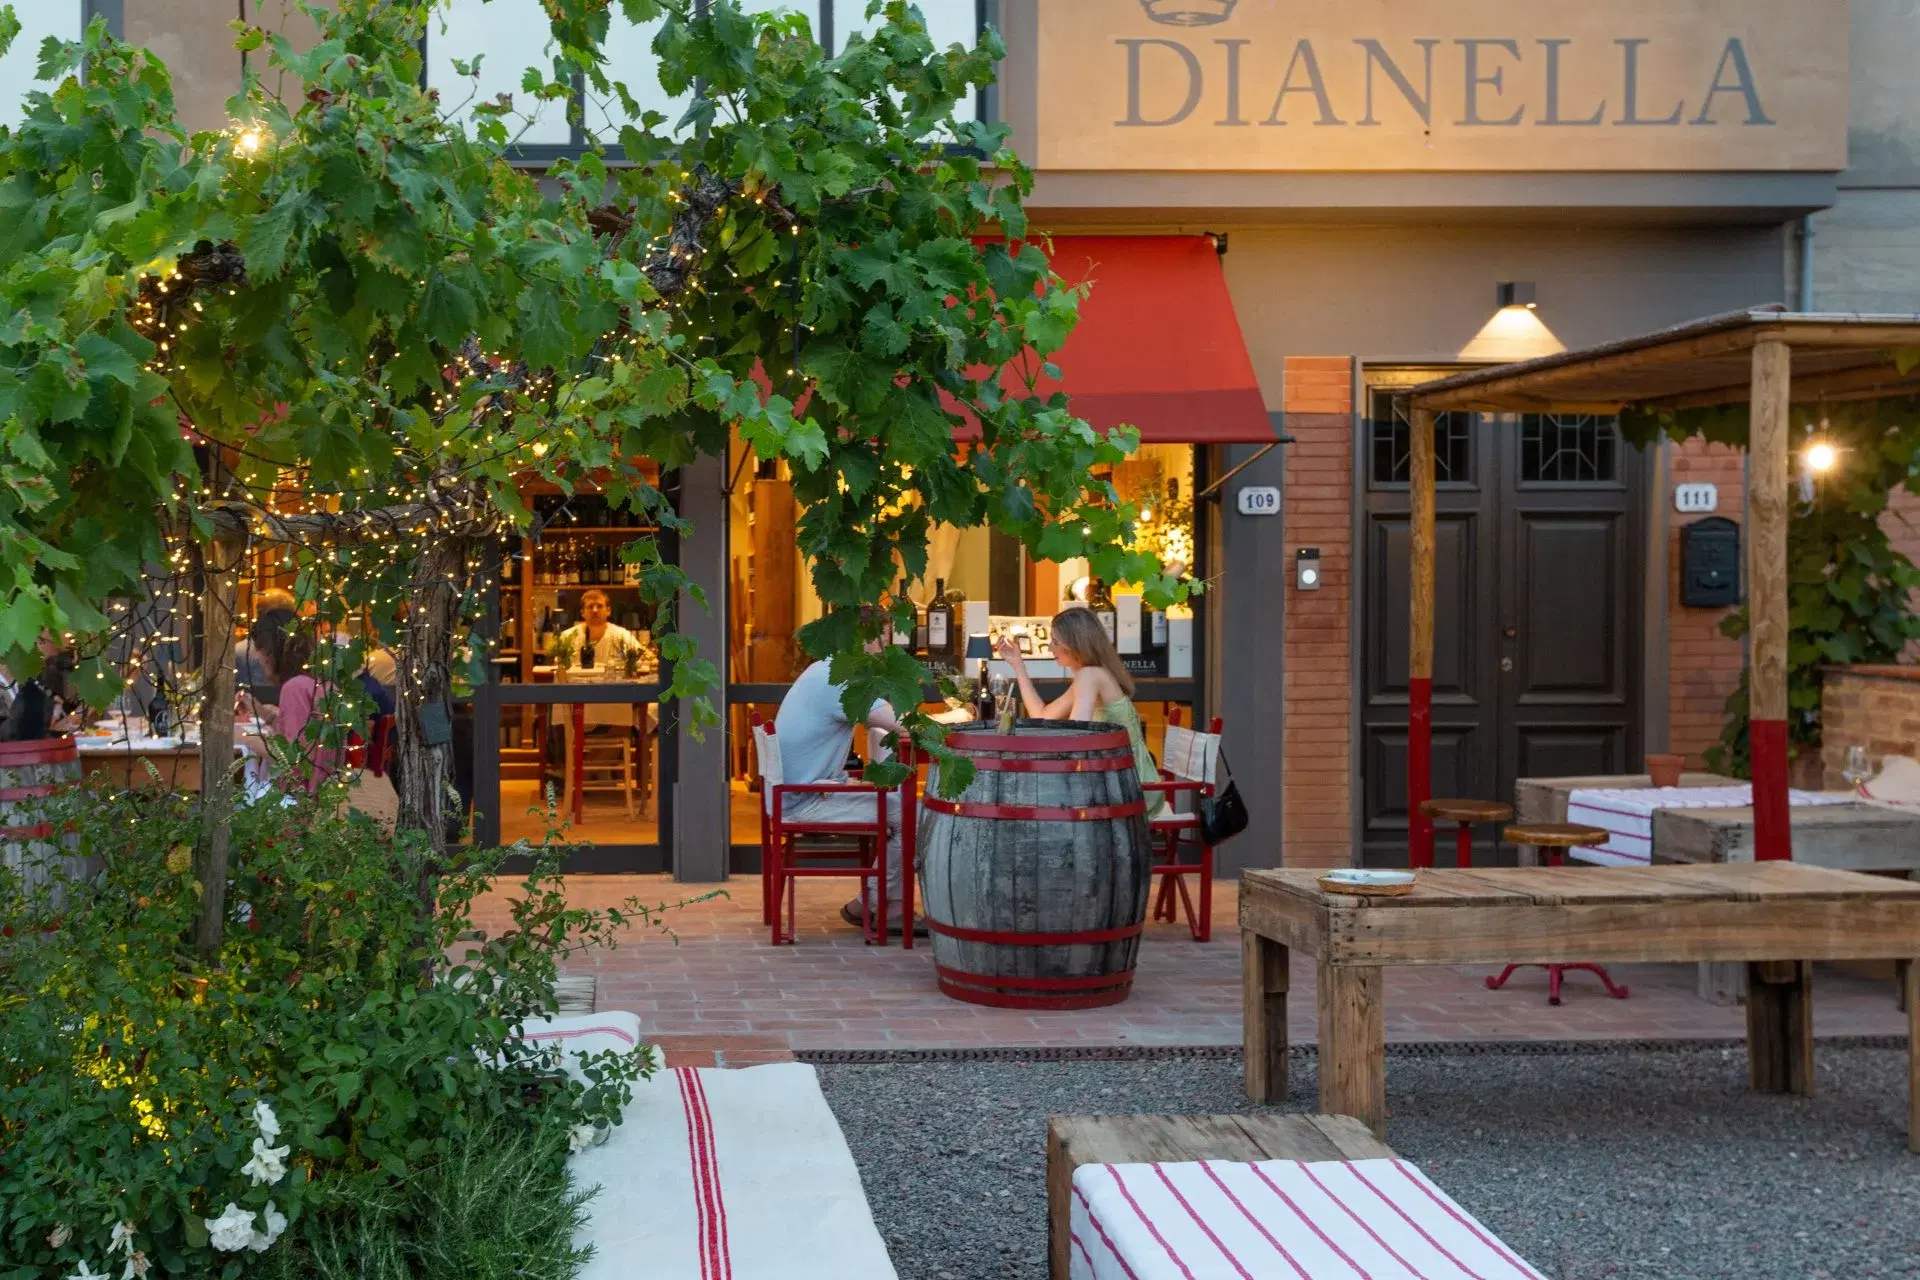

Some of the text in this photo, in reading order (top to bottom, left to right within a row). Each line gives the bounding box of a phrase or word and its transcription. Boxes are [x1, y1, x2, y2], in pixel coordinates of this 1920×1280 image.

[1113, 37, 1777, 126] DIANELLA
[1246, 493, 1274, 508] 109
[1682, 491, 1710, 505] 111
[1122, 660, 1157, 669] NELLA
